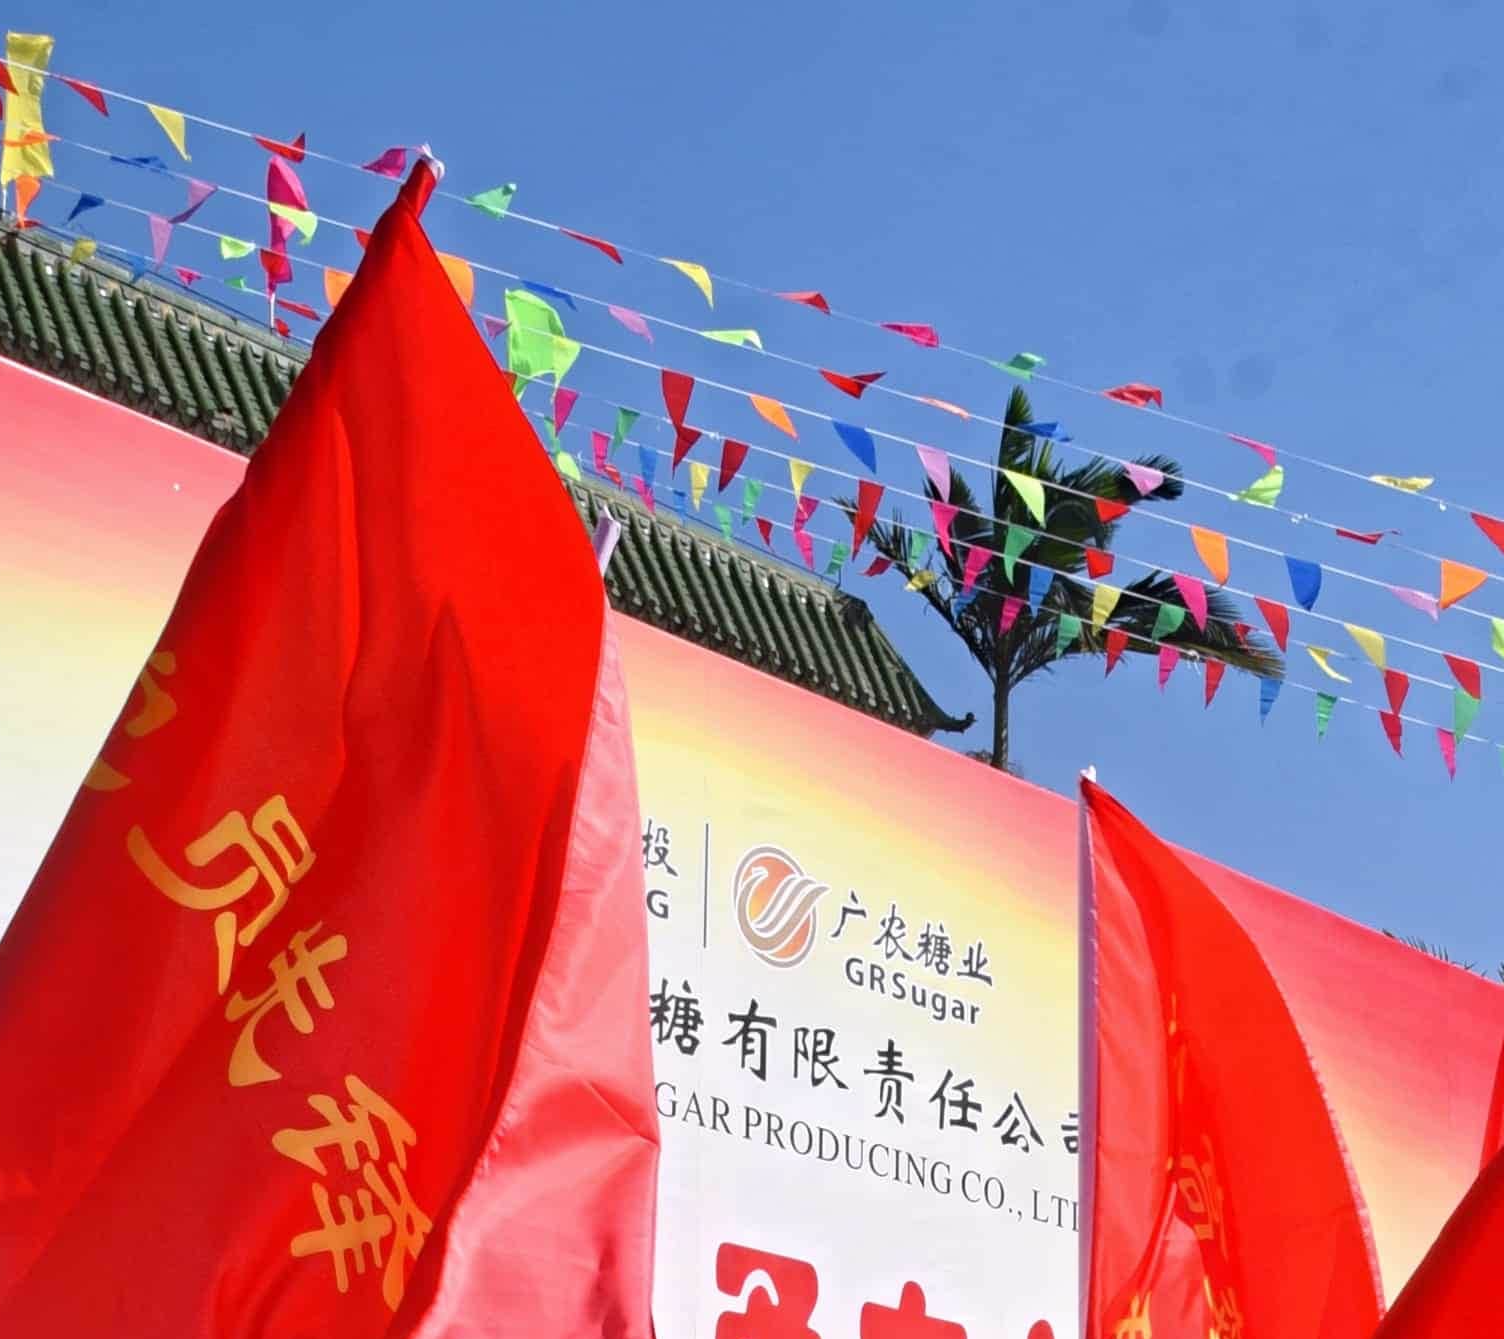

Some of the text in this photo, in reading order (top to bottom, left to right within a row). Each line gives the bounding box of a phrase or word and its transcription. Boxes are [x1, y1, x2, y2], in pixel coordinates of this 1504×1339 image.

[831, 891, 993, 987] 广农糖业
[844, 957, 981, 1024] GRSugar
[744, 1104, 953, 1196] PRODUCING
[1030, 1188, 1079, 1234] LT
